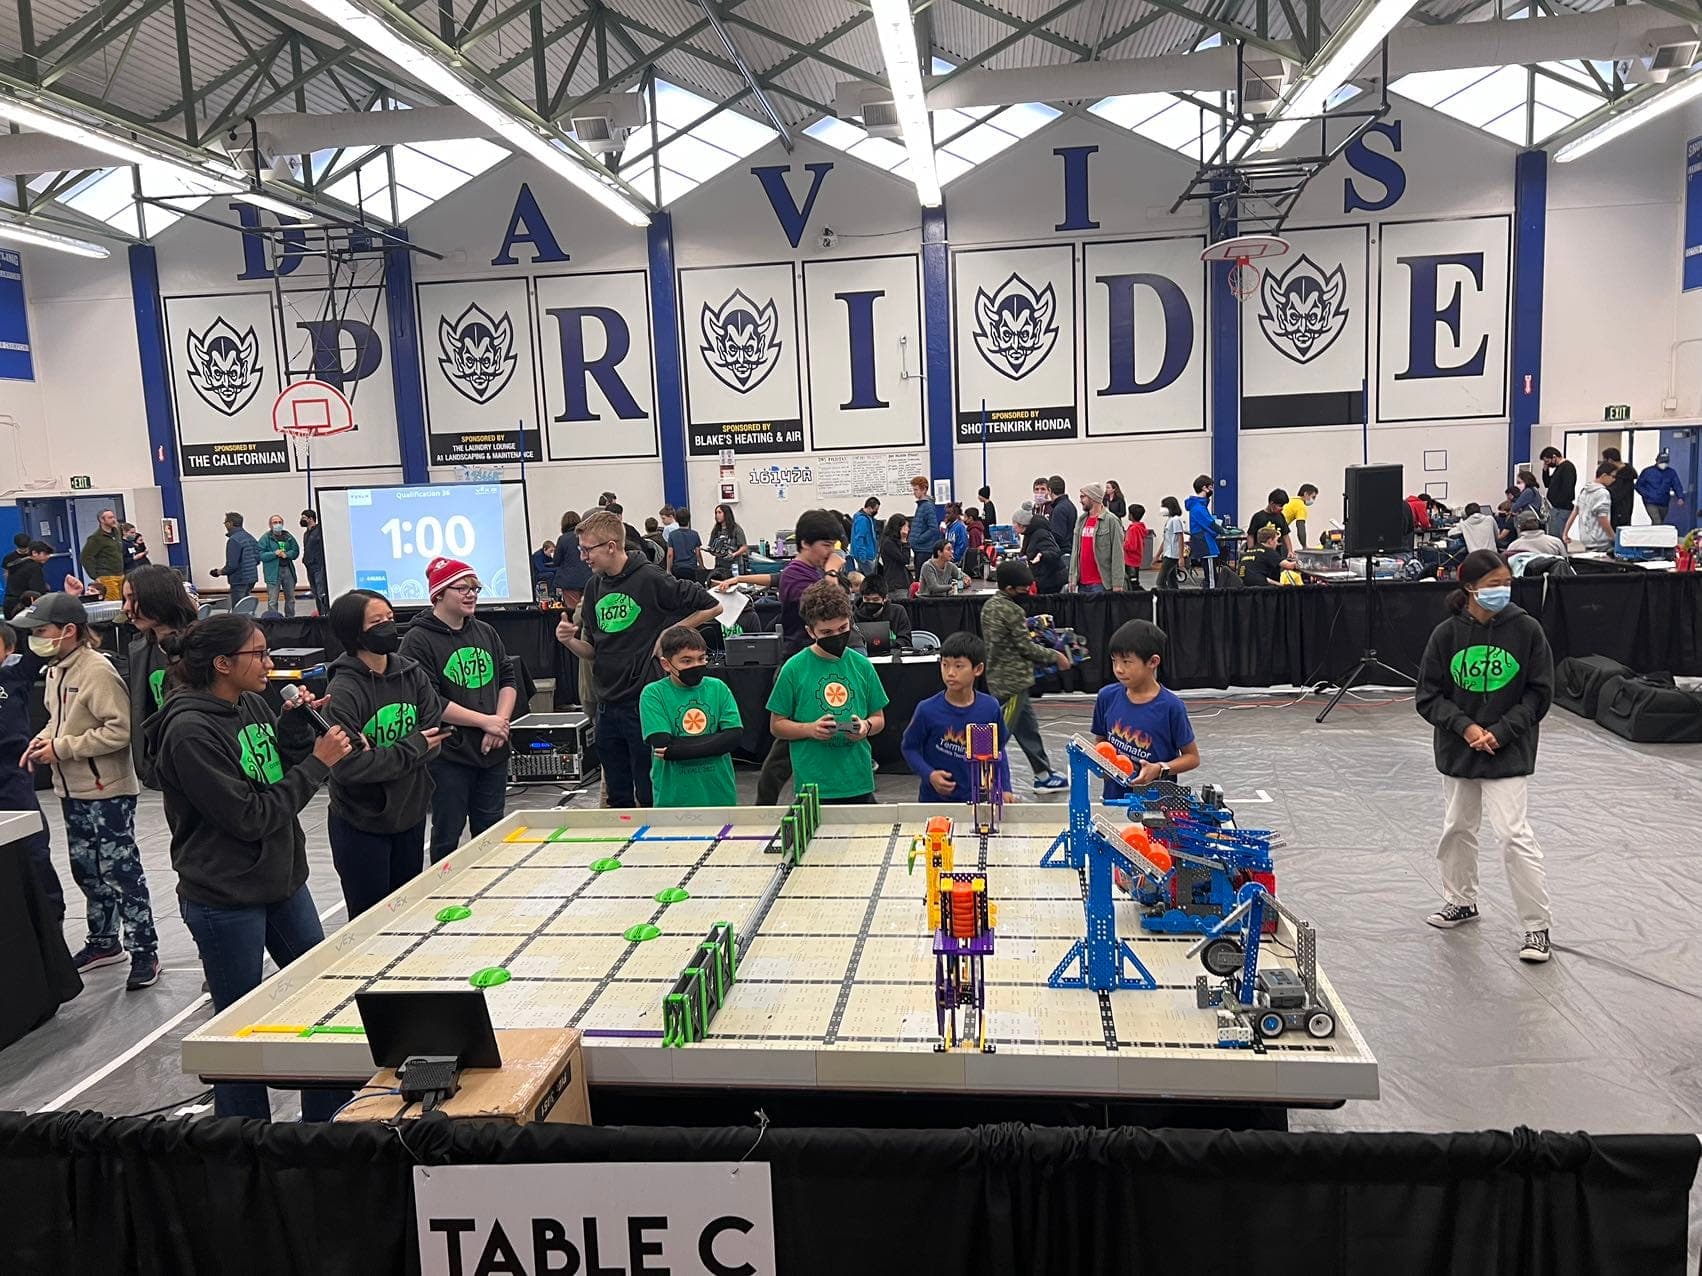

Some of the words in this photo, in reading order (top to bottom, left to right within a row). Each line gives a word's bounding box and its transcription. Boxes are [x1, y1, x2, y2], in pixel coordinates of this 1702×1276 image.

[991, 411, 1029, 420] SPONSORED
[1030, 410, 1040, 418] BY
[1609, 407, 1626, 419] EXIT
[722, 425, 761, 433] SPONSORED
[762, 423, 772, 431] BY
[1034, 418, 1072, 431] HONDA
[461, 435, 496, 443] SPONSORED
[694, 434, 732, 446] BLAKE'S
[734, 432, 773, 444] HEATING
[776, 431, 783, 443] &
[785, 430, 802, 442] AIR
[213, 444, 248, 452] SPONSORED
[248, 443, 257, 451] BY
[452, 444, 464, 452] THE
[465, 443, 492, 452] LAUNDRY
[493, 442, 516, 451] LOUNGE
[188, 455, 210, 468] THE
[212, 451, 286, 467] CALIFORNIAN
[445, 452, 486, 461] LANDSCAPING
[75, 477, 88, 488] EXIT
[396, 490, 438, 499] Qualification
[380, 515, 476, 559] 1:00
[601, 604, 627, 620] 1678
[1462, 660, 1502, 677] 1678
[377, 717, 415, 744] 1678
[1107, 731, 1152, 759] Terminator
[335, 934, 355, 952] VEX
[268, 980, 293, 1000] VEX
[429, 1216, 671, 1276] TABLE
[698, 1215, 757, 1276] C
